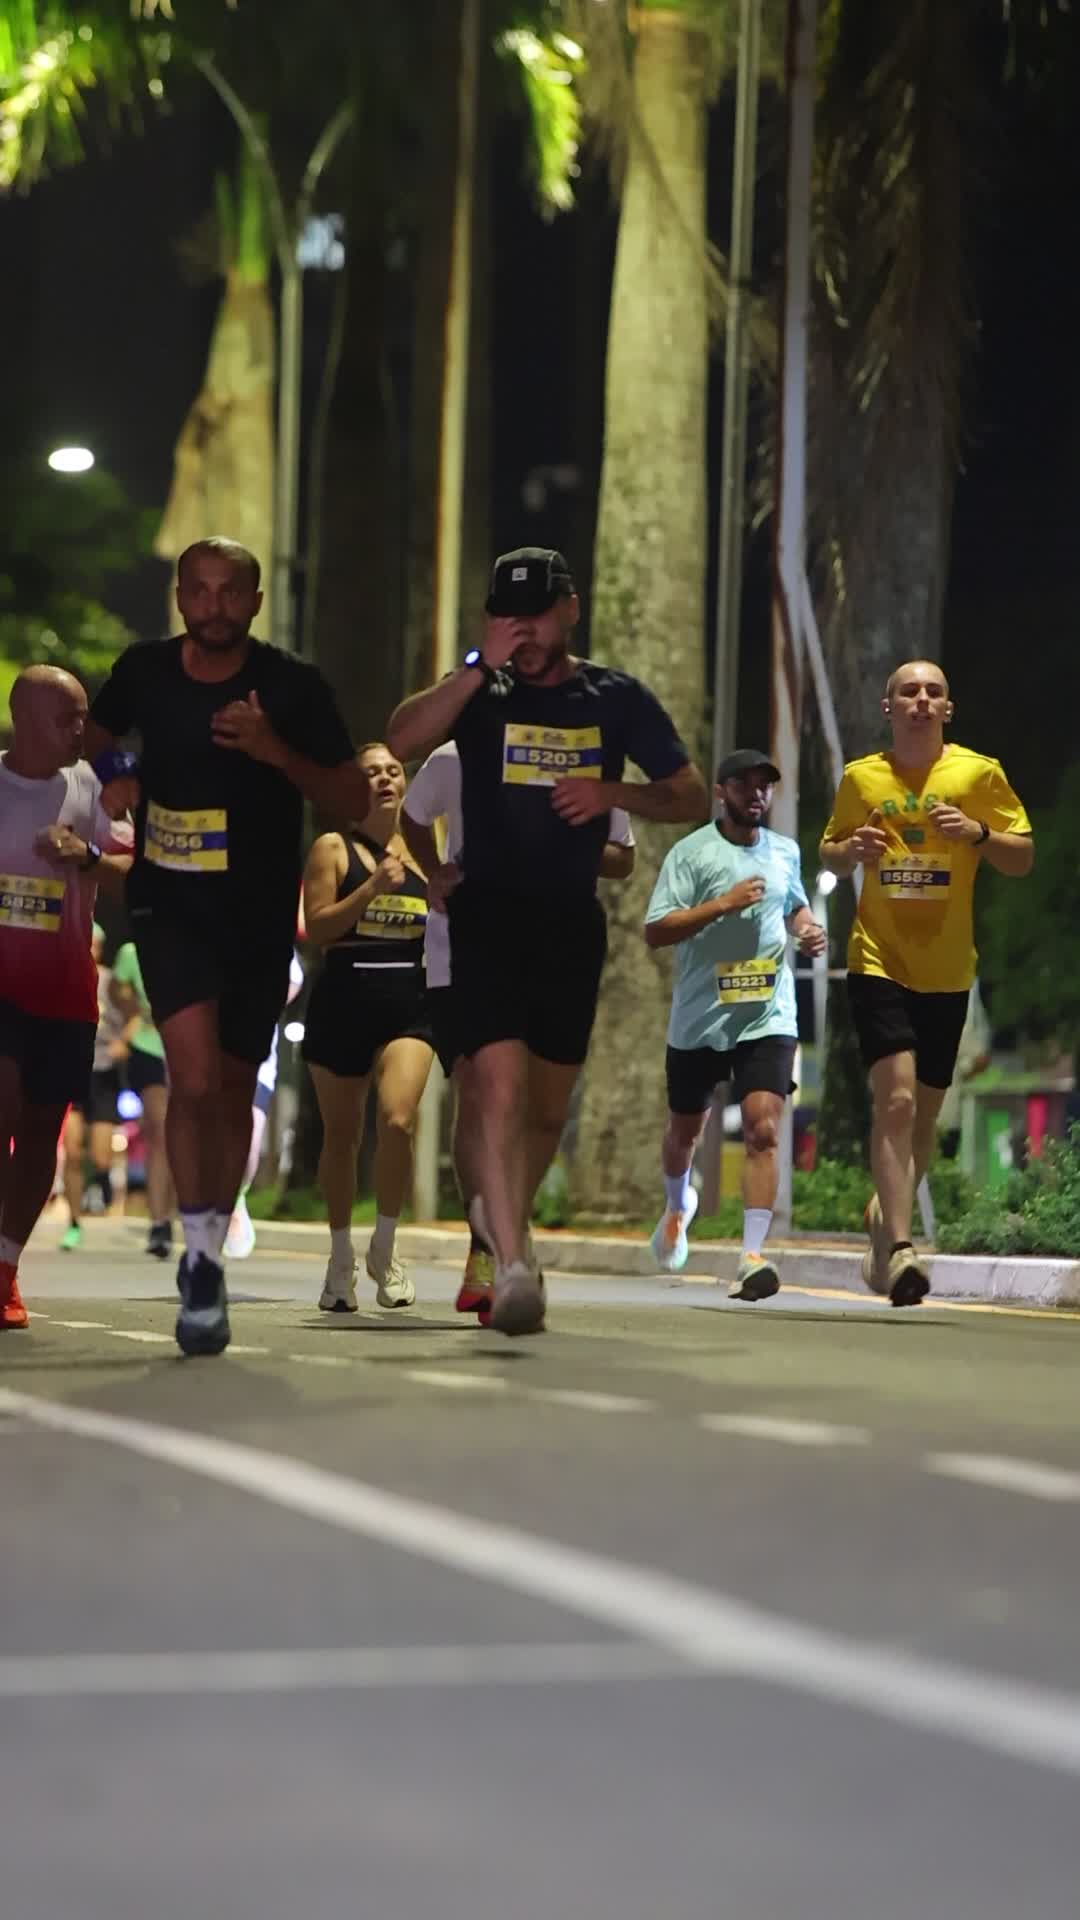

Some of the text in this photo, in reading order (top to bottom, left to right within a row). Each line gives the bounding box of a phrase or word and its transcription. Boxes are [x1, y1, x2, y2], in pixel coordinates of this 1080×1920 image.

[528, 749, 580, 766] 5203
[892, 871, 933, 884] 5582
[732, 975, 767, 988] 5223
